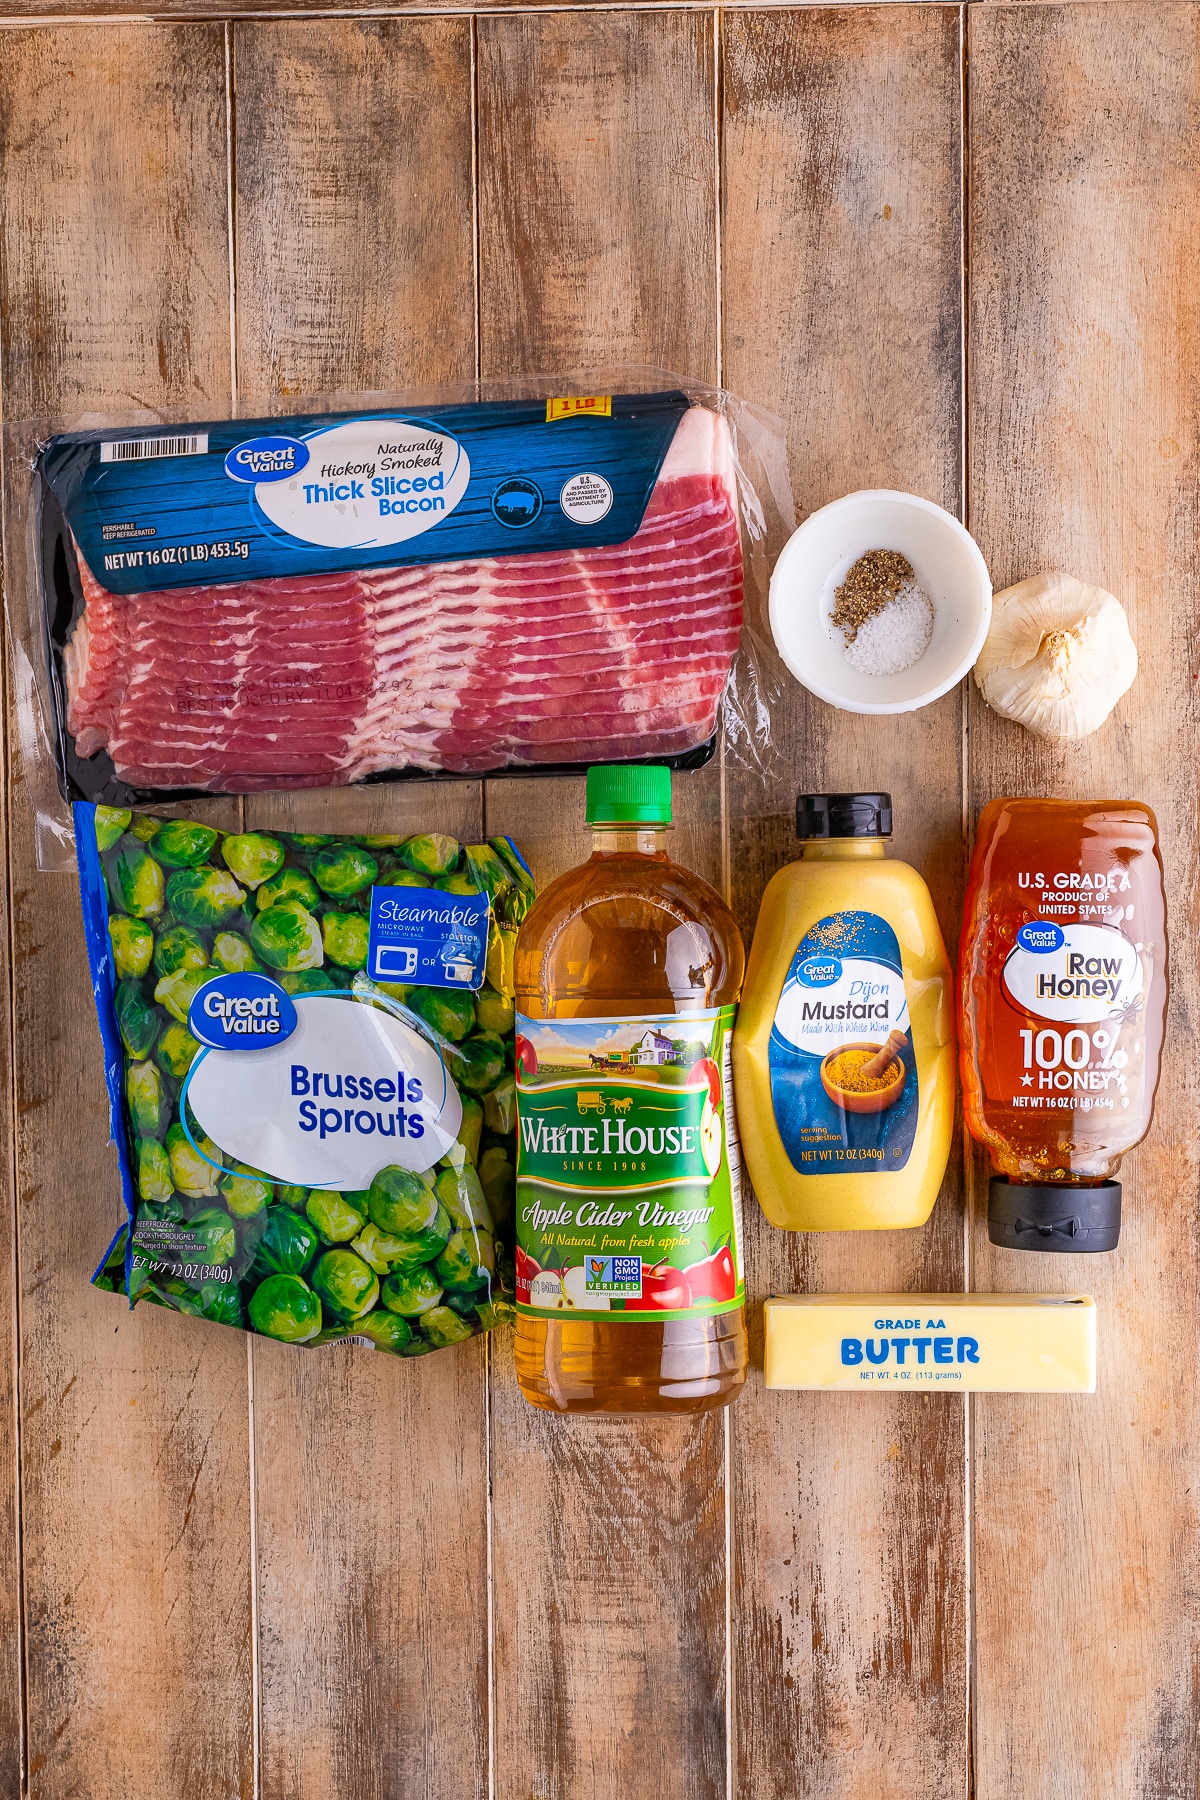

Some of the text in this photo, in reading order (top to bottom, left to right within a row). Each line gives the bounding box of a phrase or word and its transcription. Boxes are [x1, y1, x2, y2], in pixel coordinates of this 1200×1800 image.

[562, 398, 596, 411] 1 LB
[377, 438, 444, 456] Naturally
[236, 446, 295, 464] Great
[250, 460, 295, 473] Value
[320, 452, 442, 479] Hickory Smoked
[571, 483, 600, 491] INSPECTED
[580, 476, 592, 485] U.S.
[303, 471, 445, 504] Thick Sliced
[565, 494, 599, 502] DEPARTMENT
[569, 499, 605, 507] AGRICULTURE
[379, 494, 446, 517] Bacon
[102, 523, 135, 533] PERISHABLE
[103, 528, 156, 540] KEEP REFRIGERATED
[104, 541, 249, 571] NET WT 16 OZ (1 LB) 453.5g
[178, 699, 214, 711] BEST
[240, 693, 280, 708] USED
[336, 686, 352, 698] 04
[1018, 872, 1131, 889] U.S. GRADE A
[1042, 892, 1110, 902] PRODUCT OF
[378, 900, 480, 927] Steamable
[1038, 904, 1113, 915] UNITED STATES
[377, 923, 425, 932] MICROWAVE
[440, 933, 478, 942] STOVETOP
[1022, 928, 1057, 941] Great
[1030, 938, 1057, 947] Value
[422, 958, 436, 966] OR
[1066, 953, 1123, 978] Raw
[803, 963, 836, 975] Great
[810, 973, 834, 981] Value
[848, 980, 889, 1003] Dijon
[1036, 973, 1123, 1004] Honey
[203, 991, 279, 1018] Great
[801, 999, 889, 1021] Mustard
[221, 1015, 281, 1034] Value
[801, 1021, 889, 1035] Made With White Wine
[1019, 1028, 1129, 1070] 100%
[290, 1064, 423, 1103] Brussels
[1038, 1070, 1113, 1090] HONEY
[1012, 1096, 1114, 1110] NET WT 16 OZ (1 LB) 454g
[298, 1099, 425, 1139] Sprouts
[520, 1116, 598, 1155] WHITE
[600, 1117, 697, 1155] HOUSE
[800, 1127, 828, 1135] serving
[800, 1134, 842, 1143] suggestion
[801, 1150, 818, 1162] NET
[819, 1149, 833, 1161] WT
[835, 1149, 845, 1160] 12
[846, 1148, 857, 1160] OZ
[858, 1148, 885, 1161] (340g)
[563, 1160, 646, 1171] SINCE 1908
[522, 1200, 573, 1232] Apple
[575, 1201, 634, 1228] Cider
[635, 1201, 715, 1233] Vinegar
[150, 1220, 175, 1229] FROZEN
[134, 1231, 196, 1241] COOK THOROUGHLY
[540, 1232, 691, 1250] All Natural, from fresh apples
[132, 1255, 233, 1284] ET WT 12 OZ (340g)
[614, 1259, 638, 1267] NON
[614, 1266, 639, 1275] GMO
[614, 1274, 639, 1282] Project
[874, 1319, 946, 1330] GRADE AA
[840, 1336, 981, 1366] BUTTER
[860, 1371, 962, 1380] NET WT. 4 OZ. (113 grams)
